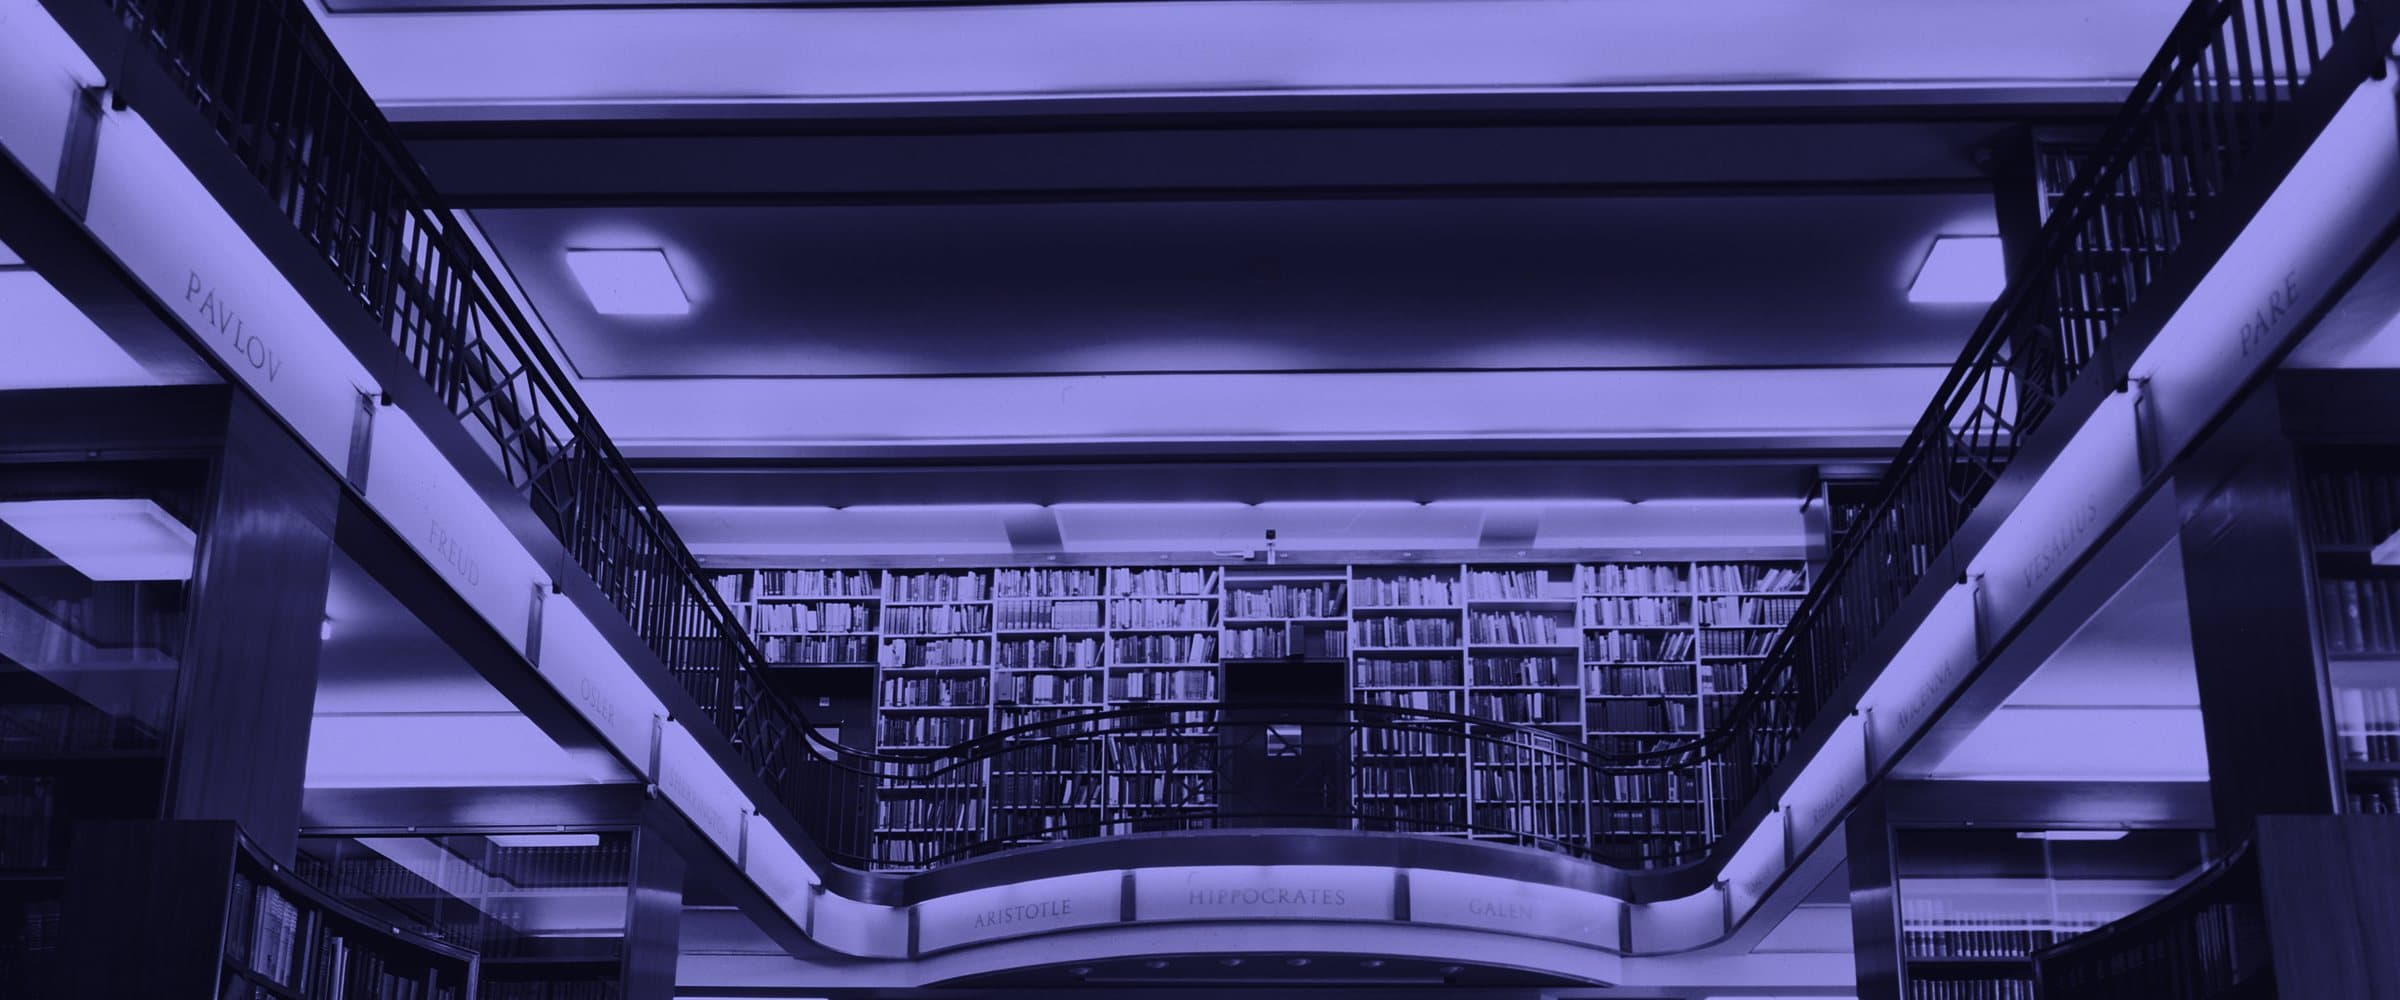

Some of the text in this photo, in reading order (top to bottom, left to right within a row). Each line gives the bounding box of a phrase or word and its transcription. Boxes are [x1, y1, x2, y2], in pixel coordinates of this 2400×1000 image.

[185, 269, 283, 383] PAVLOV
[429, 519, 480, 587] FREUD
[580, 677, 616, 728] OSLER
[974, 898, 1072, 929] ARISTOTLE
[1188, 887, 1347, 906] HIPPOCRATES
[1468, 898, 1534, 920] GALEN
